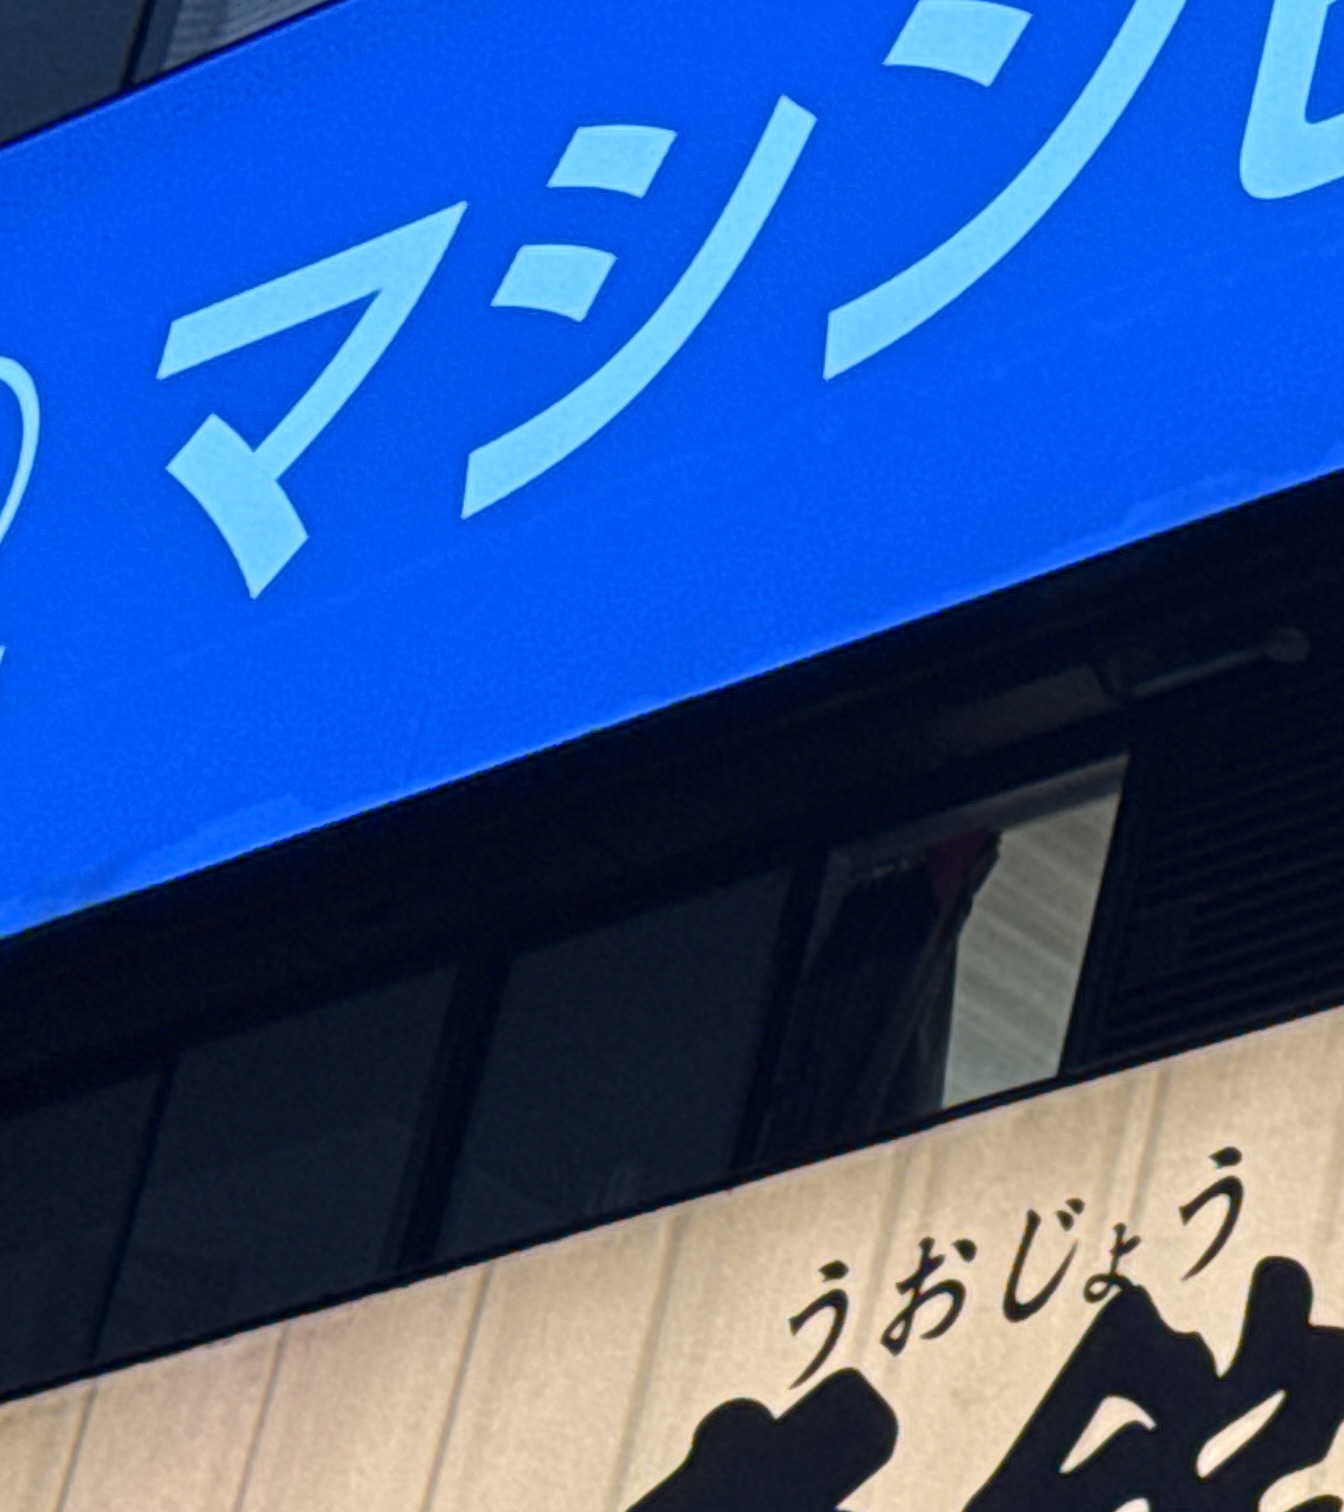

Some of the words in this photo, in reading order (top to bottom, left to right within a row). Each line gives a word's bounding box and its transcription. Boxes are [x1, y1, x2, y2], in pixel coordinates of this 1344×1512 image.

[786, 1145, 1245, 1390] うおじょう
